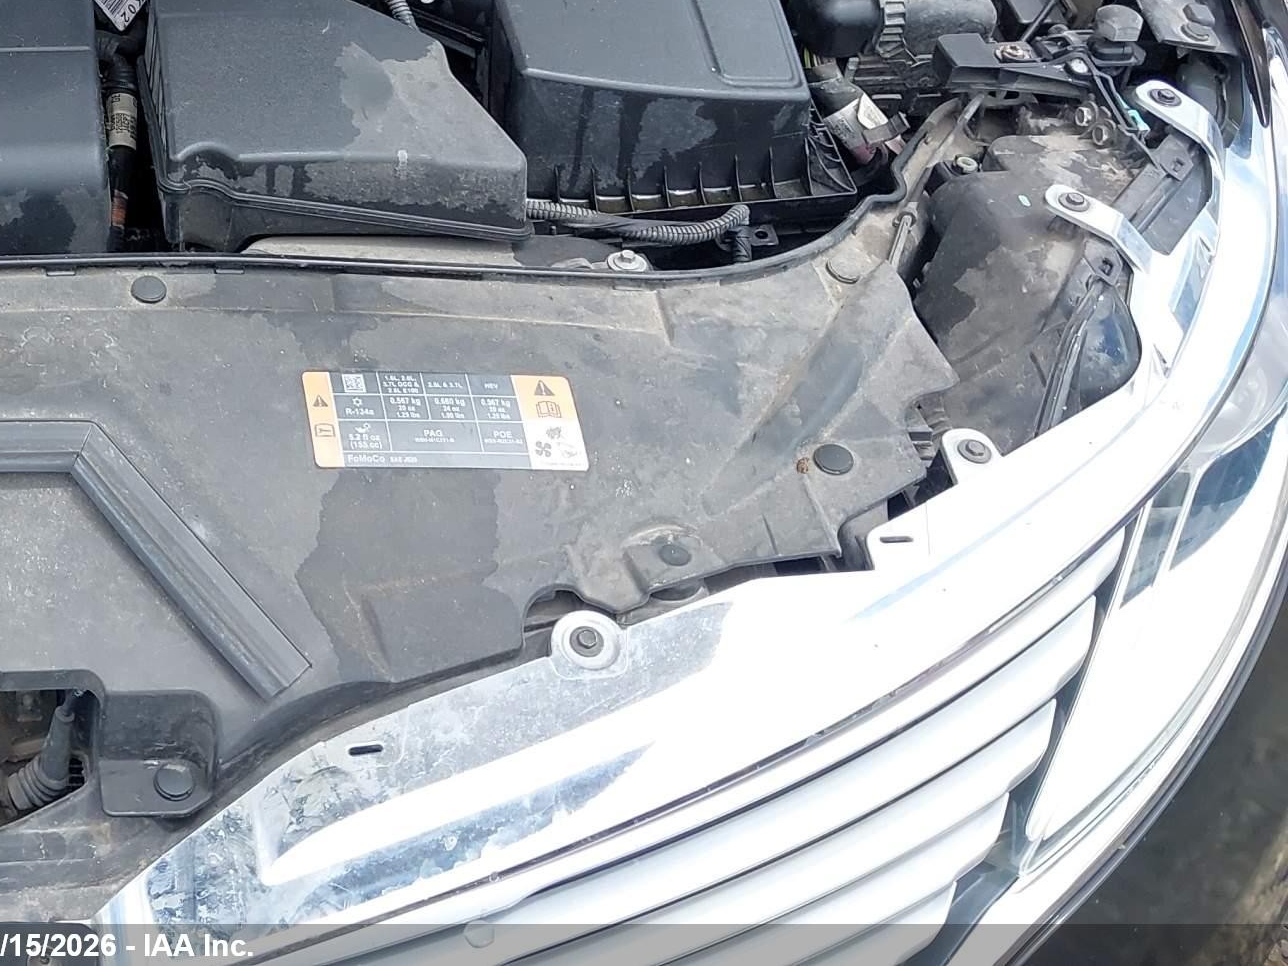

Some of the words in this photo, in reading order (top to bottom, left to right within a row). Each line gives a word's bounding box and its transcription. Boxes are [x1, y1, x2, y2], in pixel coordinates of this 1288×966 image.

[410, 397, 421, 406] kg
[455, 398, 466, 407] kg
[501, 399, 511, 407] kg
[345, 407, 375, 416] R-134a
[493, 430, 513, 438] POE
[347, 454, 385, 463] FoMoCo
